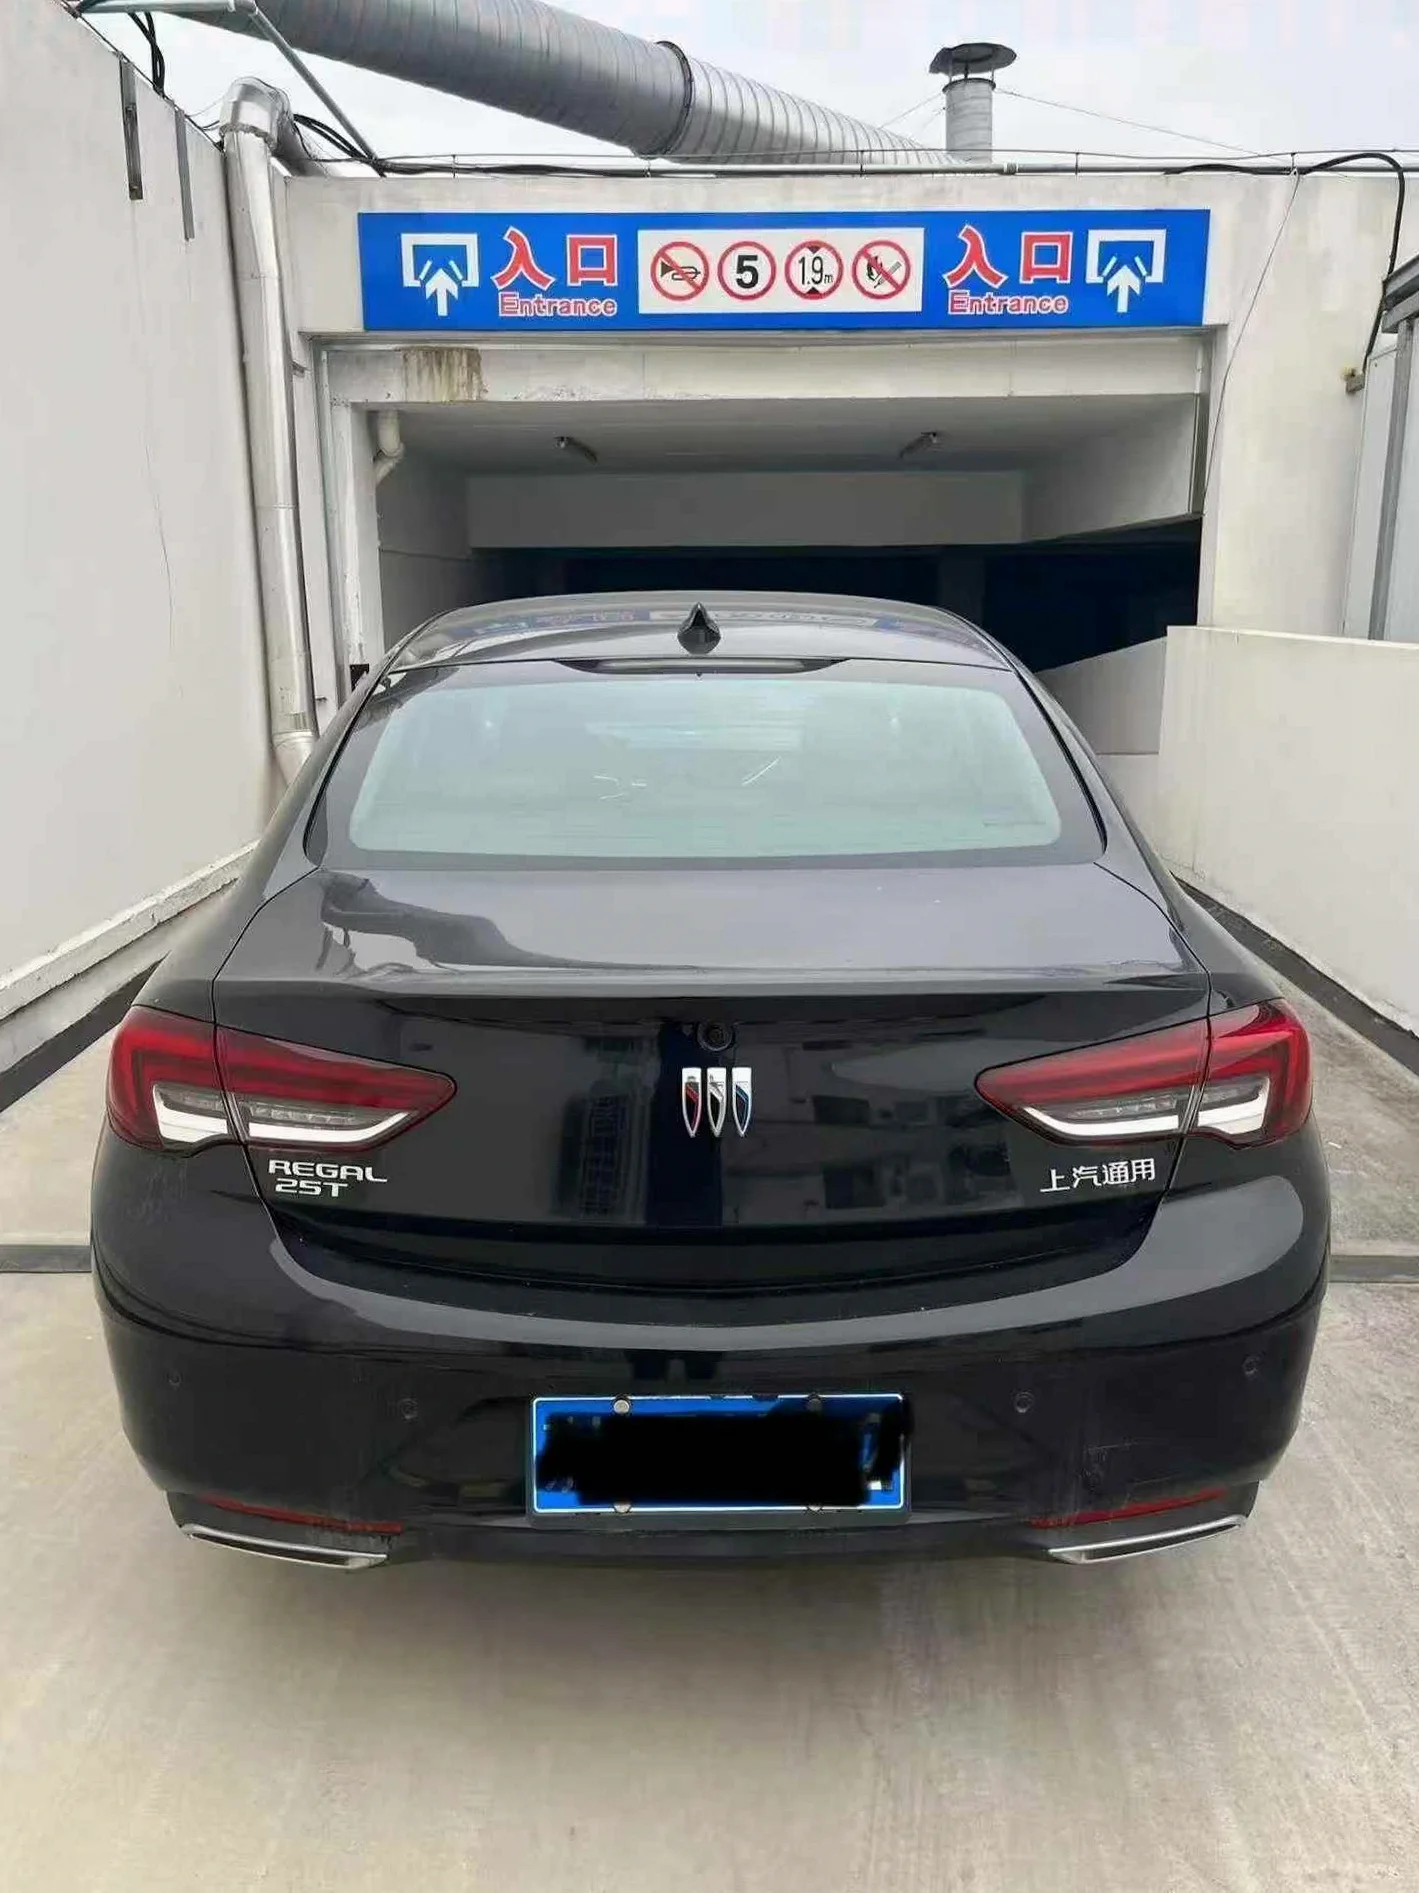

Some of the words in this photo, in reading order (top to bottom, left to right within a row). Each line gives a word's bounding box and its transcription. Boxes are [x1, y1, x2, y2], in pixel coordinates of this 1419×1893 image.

[490, 226, 618, 291] 入口
[943, 224, 1074, 289] 入口
[735, 255, 759, 289] 5
[498, 291, 618, 317] Entrance
[947, 289, 1070, 315] Entrance
[268, 1159, 388, 1182] REGAL
[1039, 1158, 1156, 1192] 上汽通用
[275, 1178, 348, 1197] 25T
